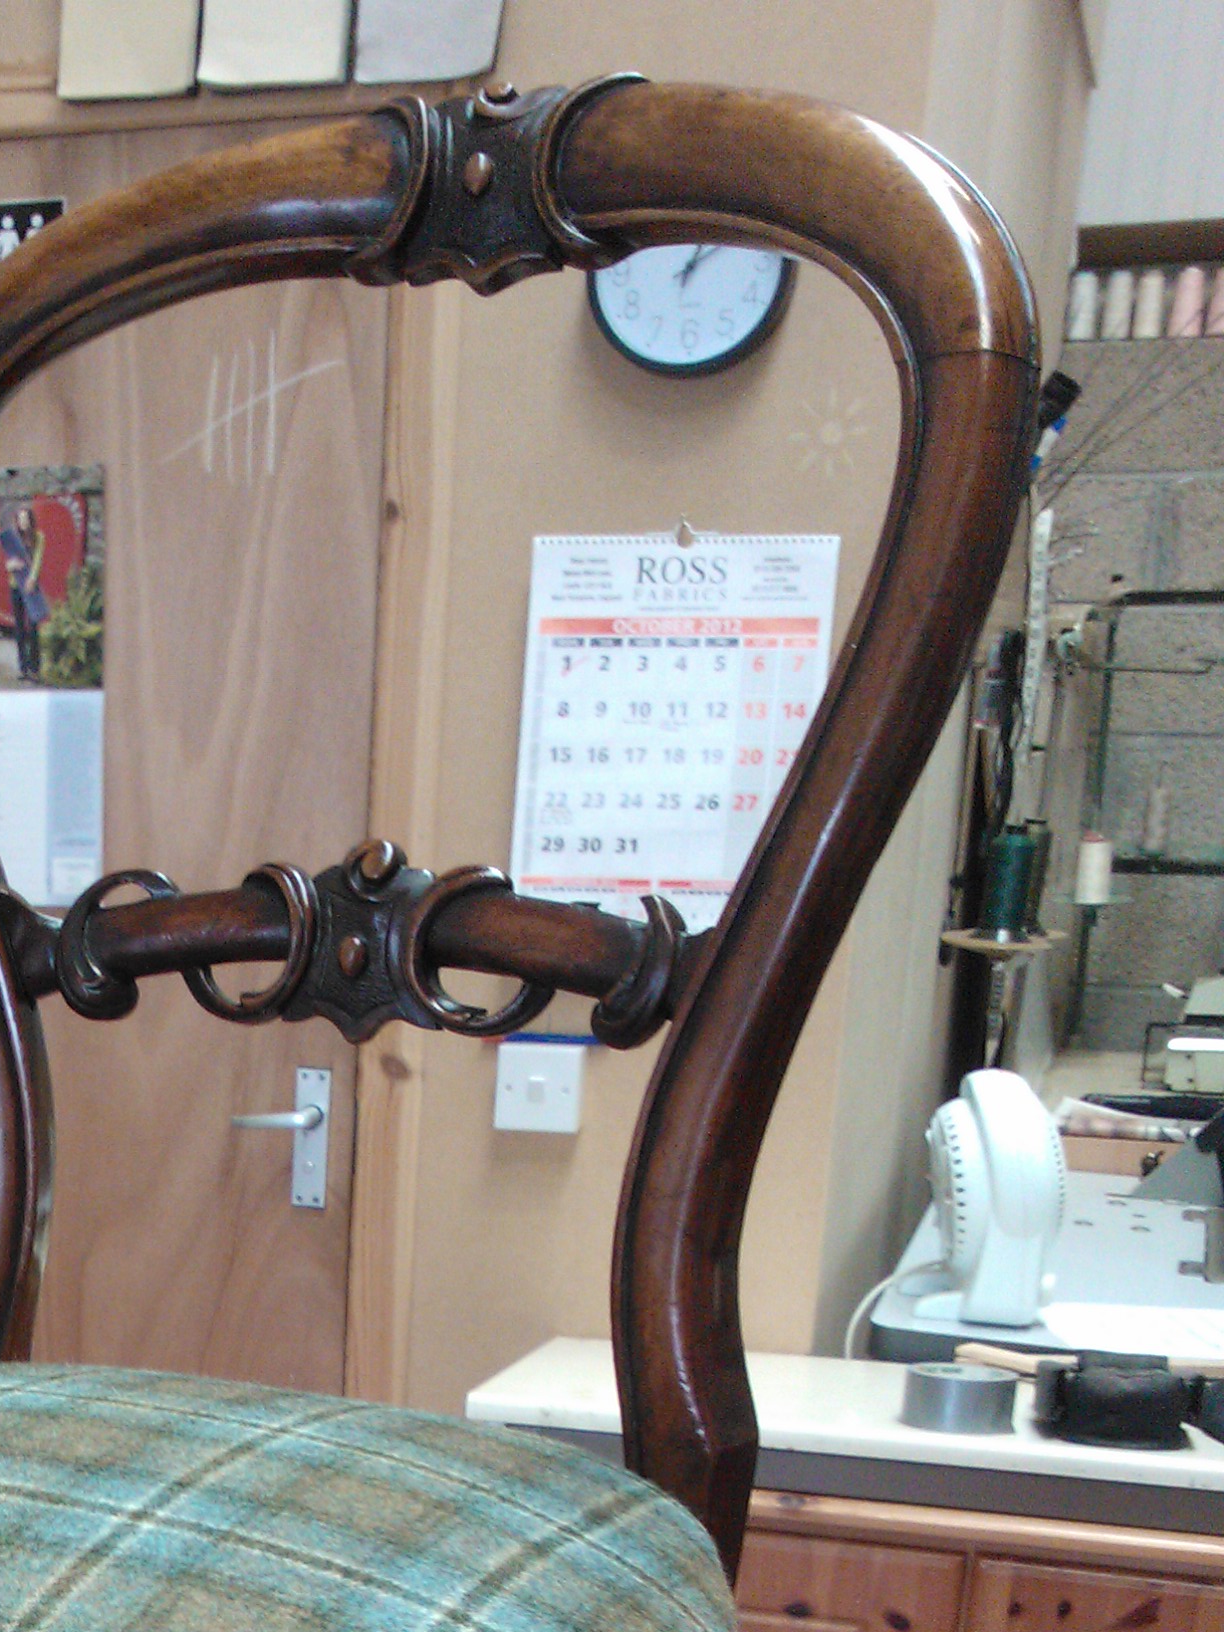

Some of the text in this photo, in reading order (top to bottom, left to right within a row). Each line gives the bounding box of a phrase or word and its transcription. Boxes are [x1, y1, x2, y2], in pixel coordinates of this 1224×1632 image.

[624, 289, 640, 320] 8
[715, 309, 734, 336] 5
[682, 319, 700, 349] 6
[636, 556, 729, 586] ROSS
[633, 587, 728, 602] FABRICS
[612, 618, 742, 635] OCTOBER 2012
[562, 655, 804, 672] 1 2 3 4 5 6 7
[557, 701, 806, 719] 8 9 10 11 12 13 14
[550, 747, 571, 763] 15
[587, 747, 609, 763] 16
[626, 747, 647, 763] 17
[664, 748, 685, 764] 18
[702, 748, 724, 764] 19
[738, 748, 763, 765] 20
[545, 793, 758, 811] 22 23 24 25 26 27
[541, 837, 638, 853] 29 30 31
